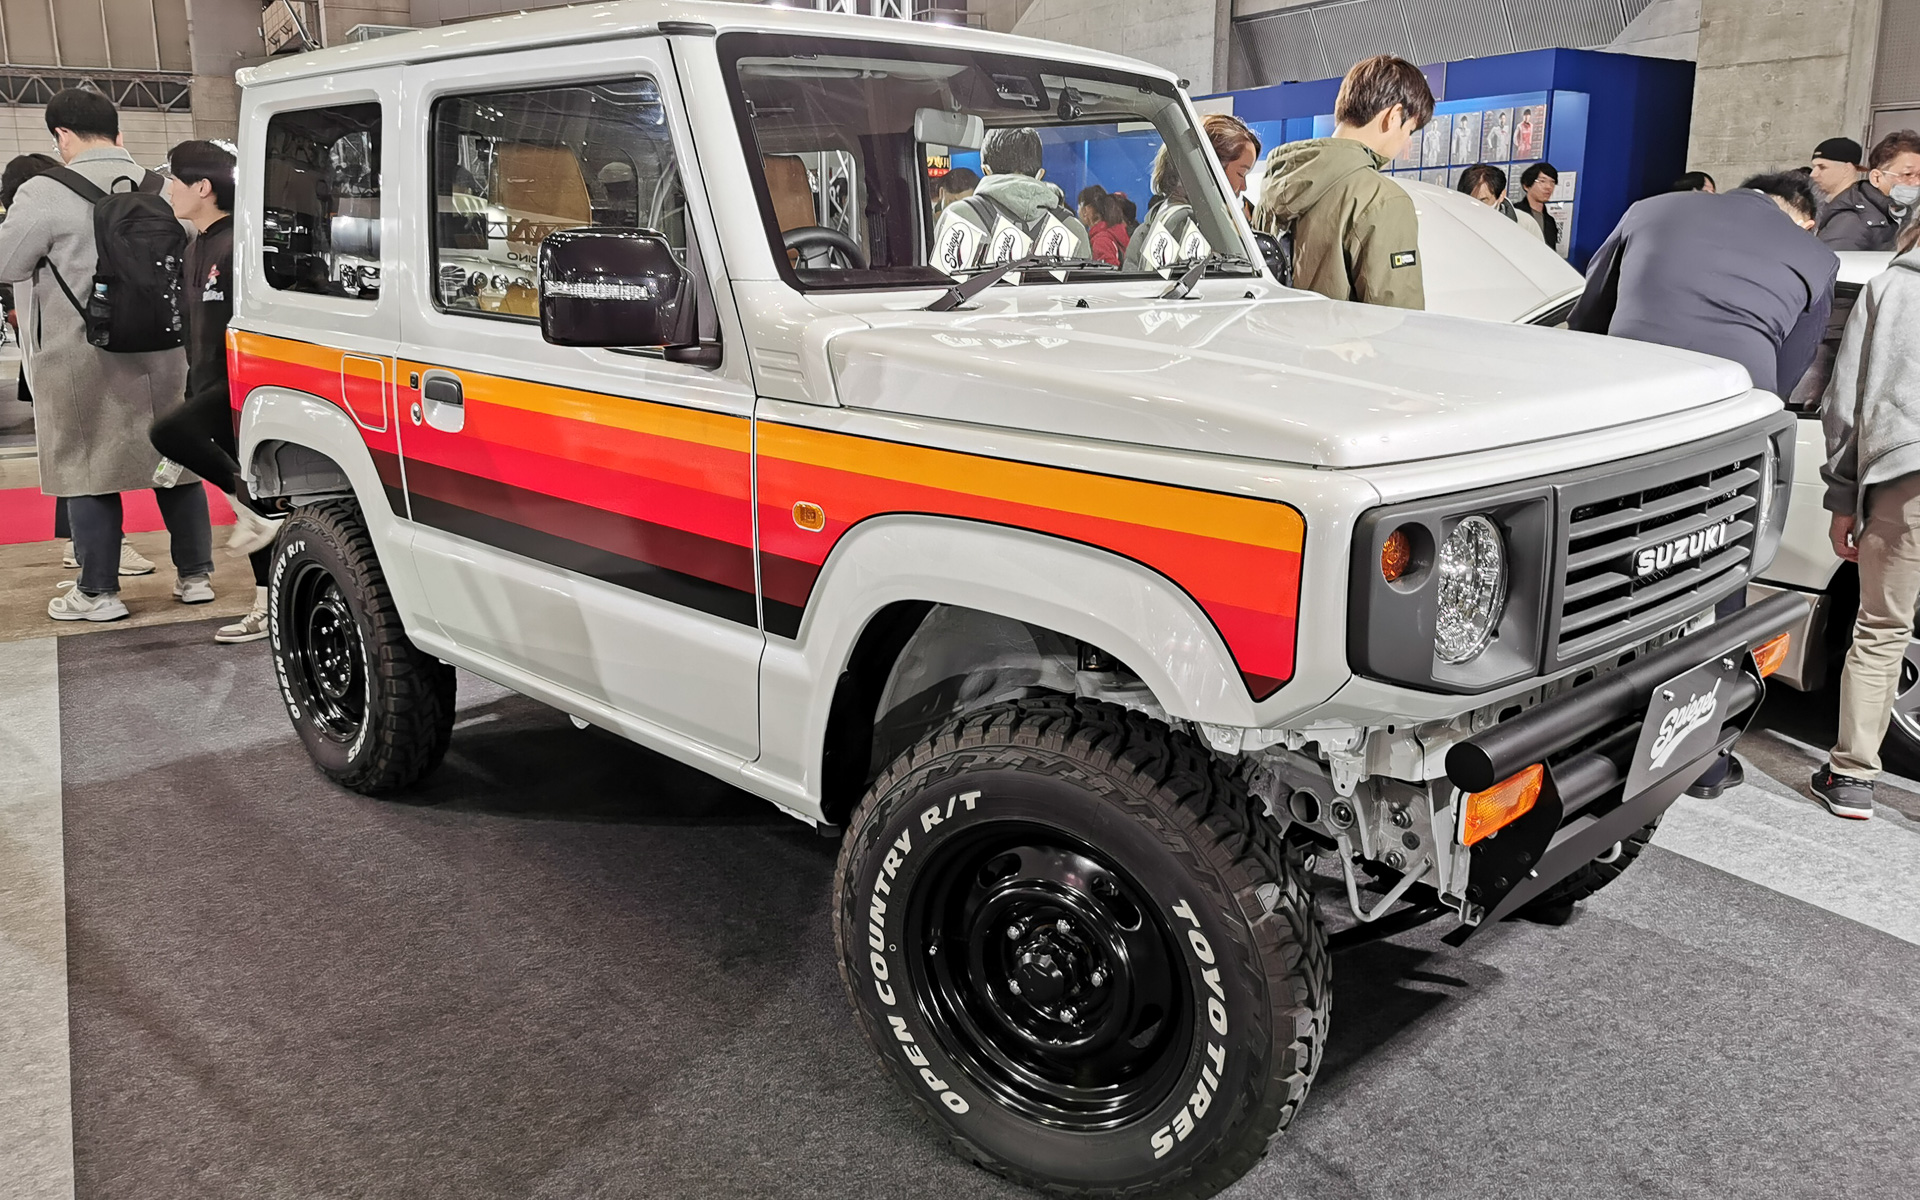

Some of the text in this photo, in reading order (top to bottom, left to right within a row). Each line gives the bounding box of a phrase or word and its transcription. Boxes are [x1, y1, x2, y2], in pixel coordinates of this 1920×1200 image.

[944, 227, 964, 269] Spiegel
[1637, 523, 1727, 577] SUZUKI
[271, 540, 306, 719] OPEN COUNTRY R/T
[1650, 677, 1721, 769] Spiegel
[867, 790, 983, 1114] OPEN COUNTRY R/T
[1150, 899, 1229, 1160] TOYO TIRES
